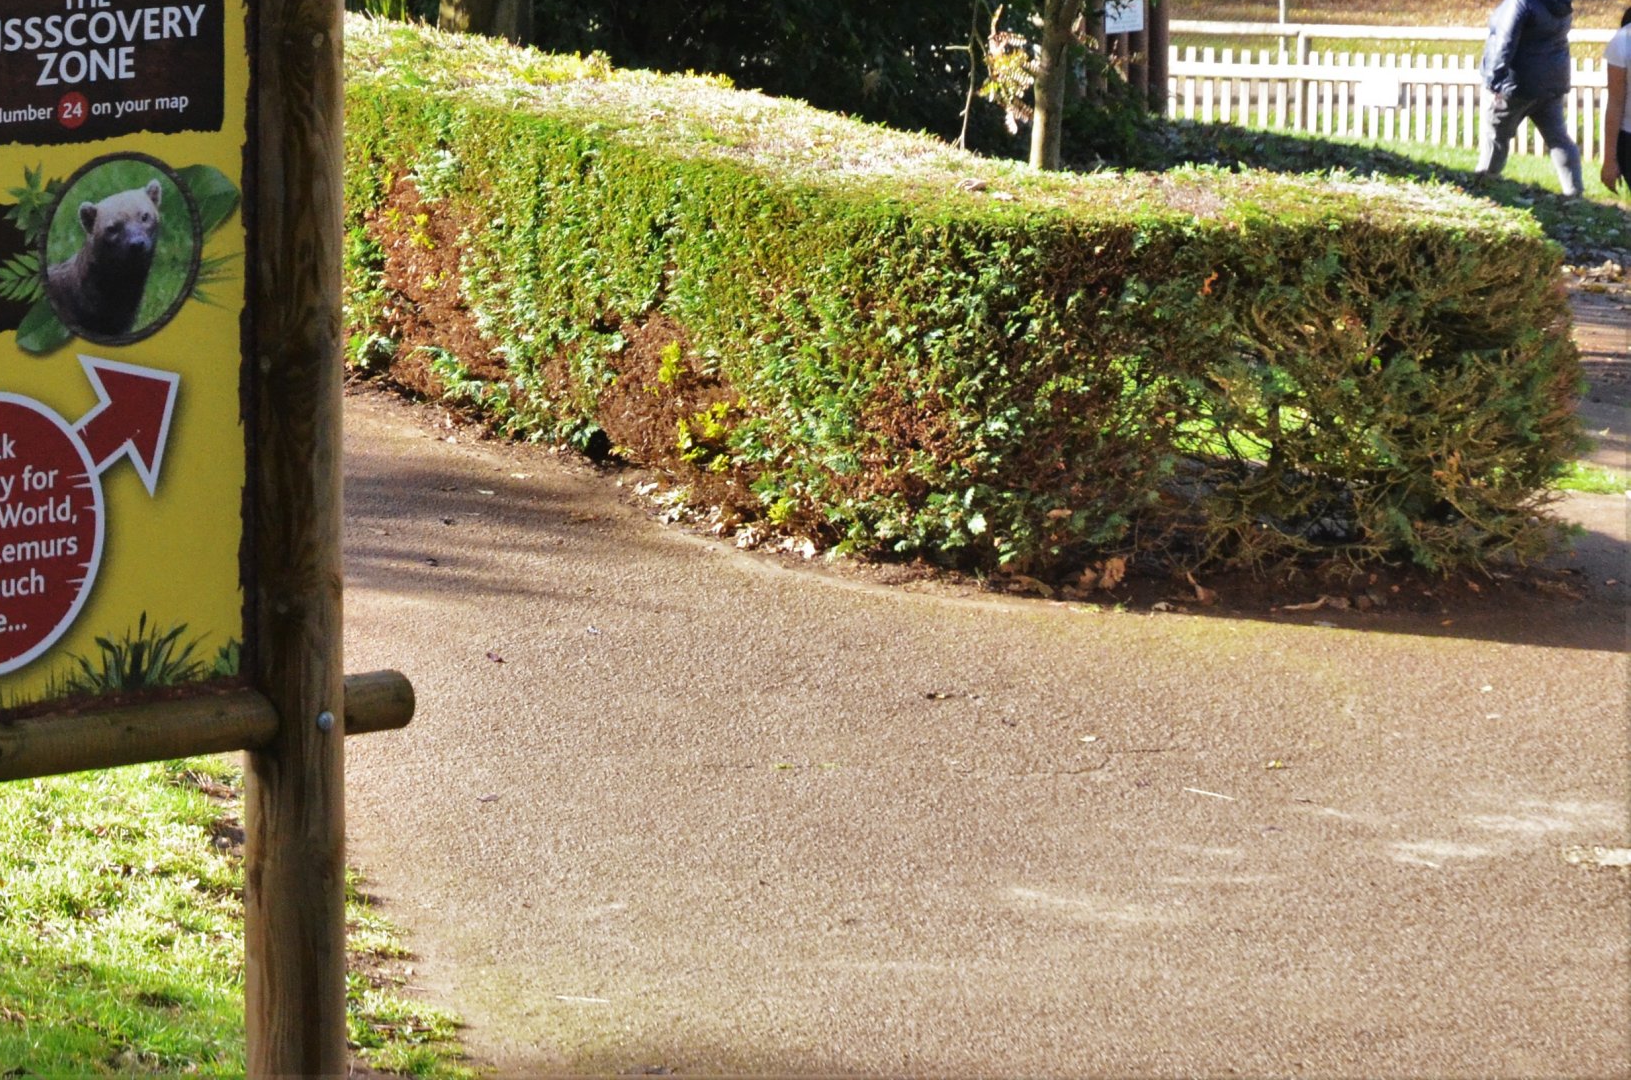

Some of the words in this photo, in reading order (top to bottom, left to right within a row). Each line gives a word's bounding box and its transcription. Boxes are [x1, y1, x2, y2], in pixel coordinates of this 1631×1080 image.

[35, 46, 136, 86] ZONE
[62, 101, 83, 119] 24
[91, 102, 112, 116] on
[114, 98, 152, 120] your
[154, 95, 190, 117] map
[22, 465, 58, 494] for
